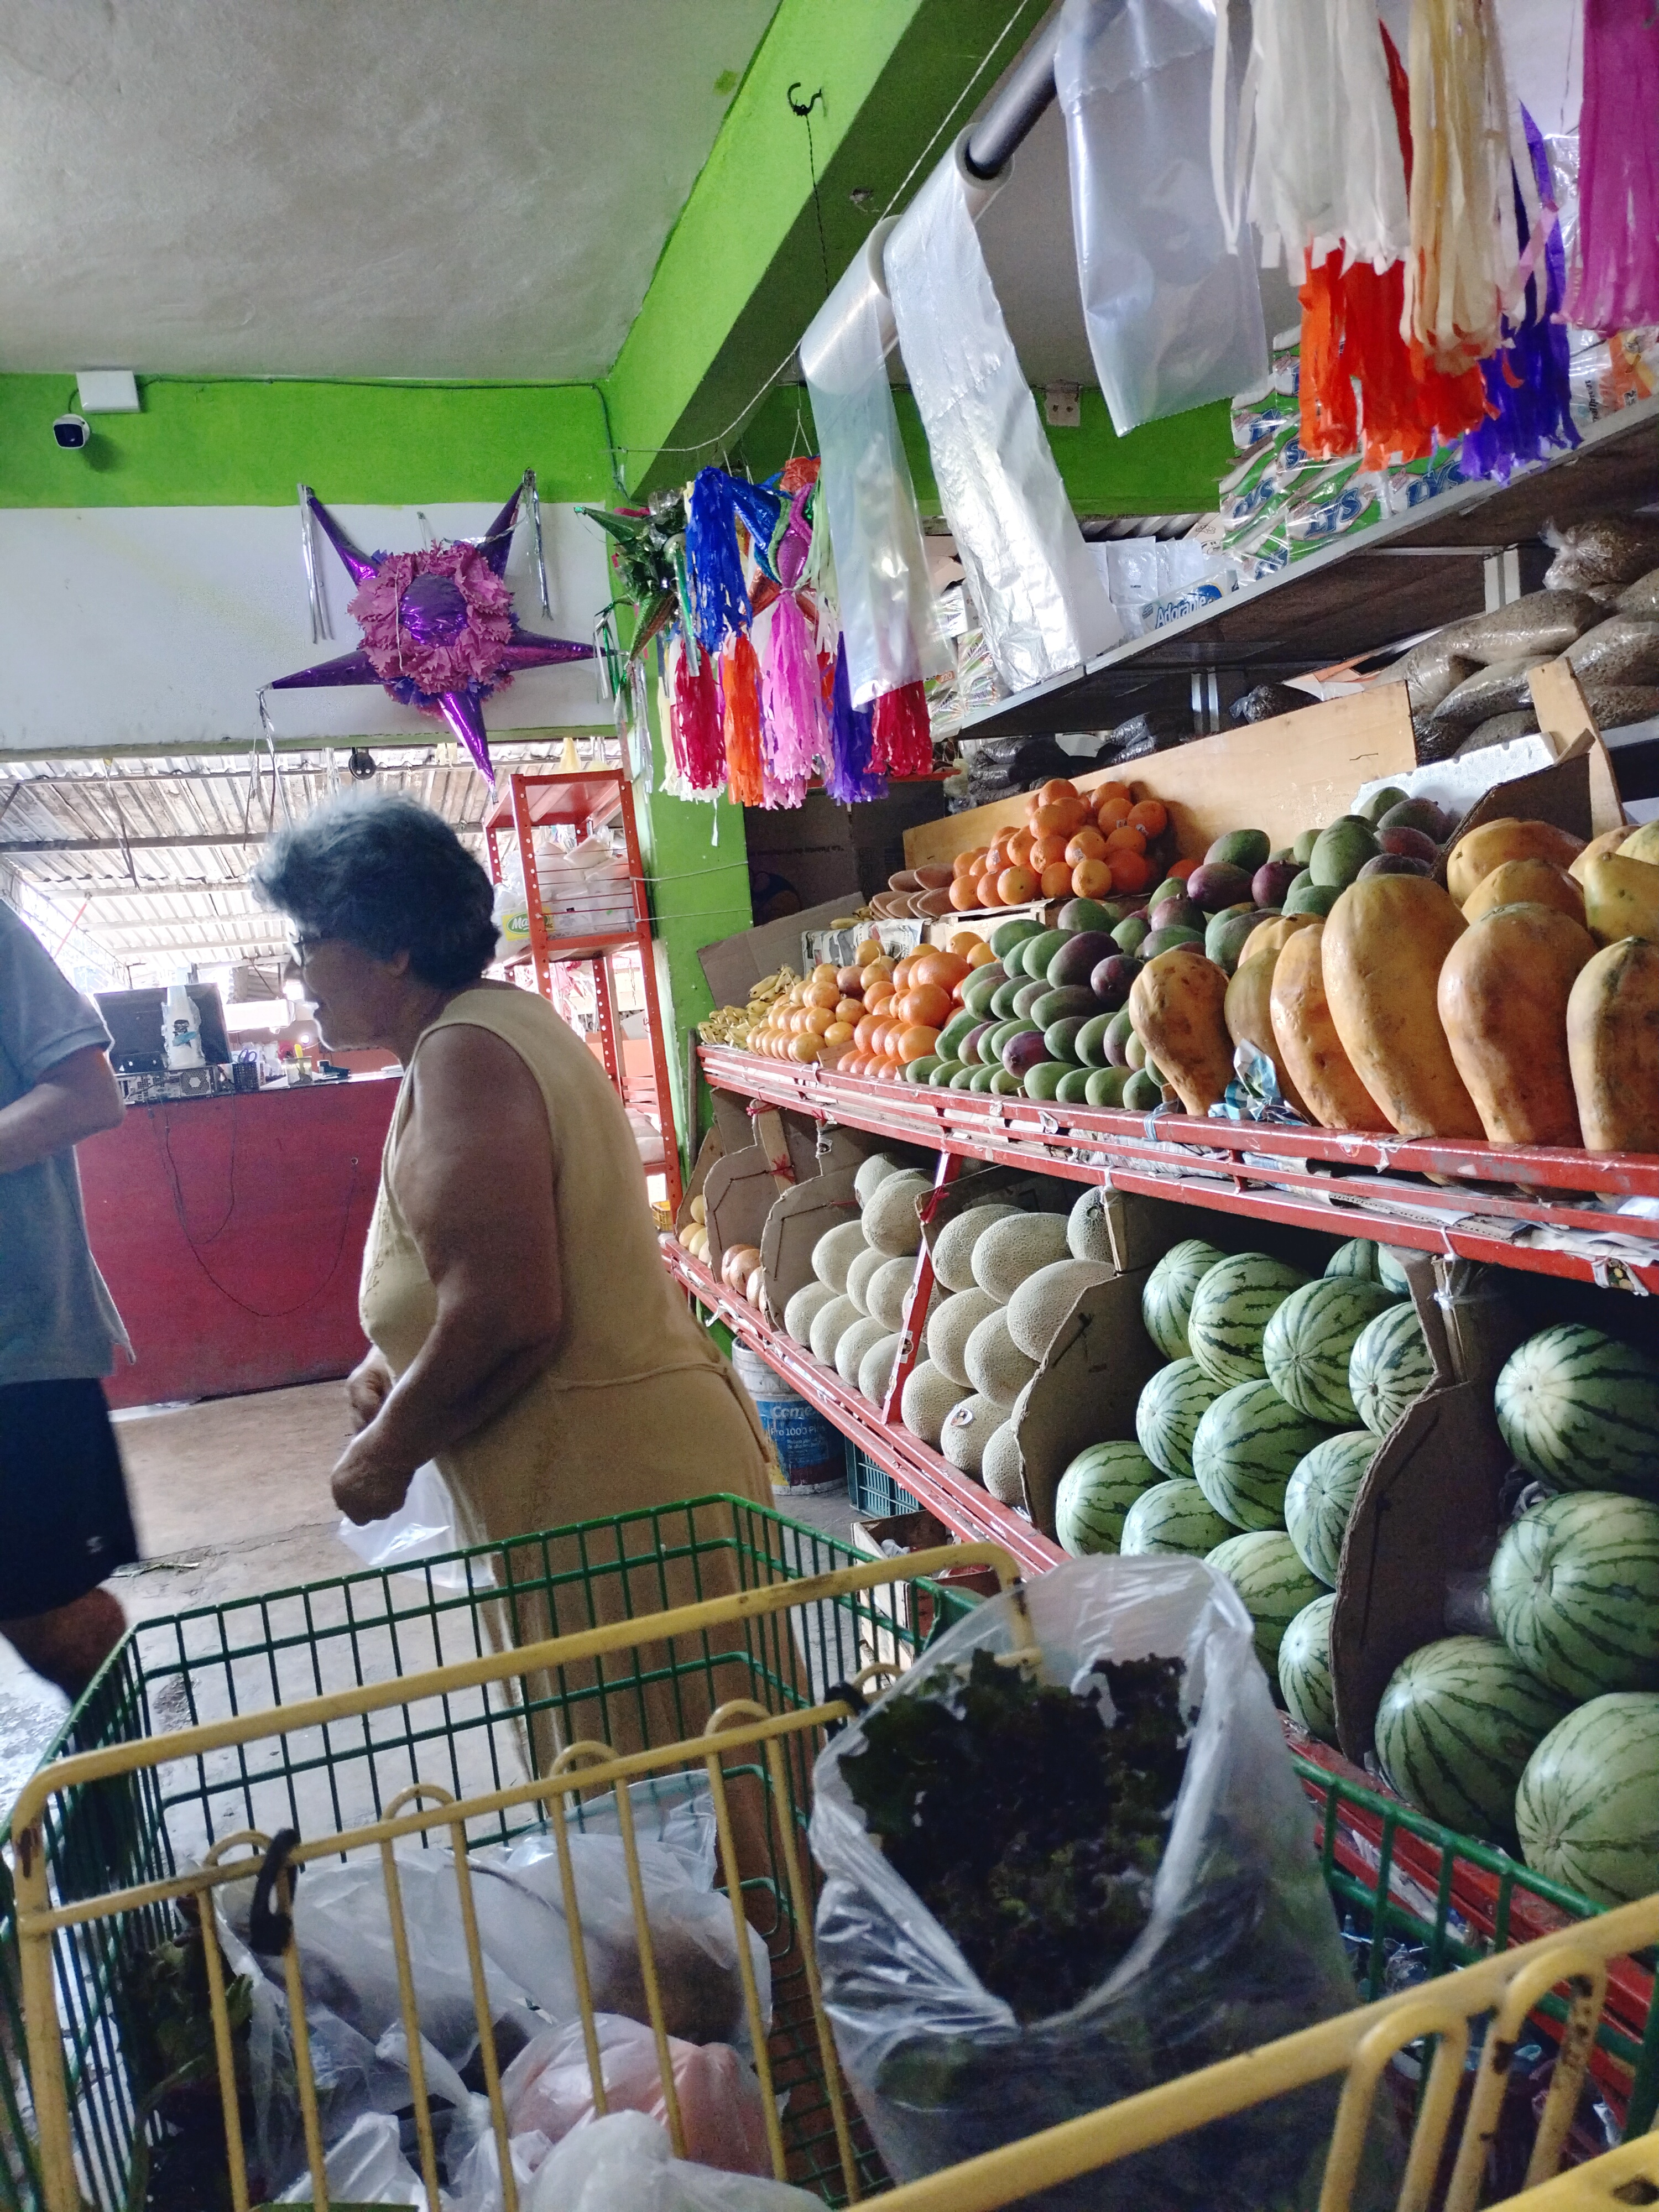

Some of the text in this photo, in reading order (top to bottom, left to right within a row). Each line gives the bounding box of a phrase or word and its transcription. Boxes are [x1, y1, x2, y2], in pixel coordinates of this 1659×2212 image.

[1248, 407, 1281, 445] LY
[1303, 488, 1361, 540] LYS
[941, 671, 953, 683] 220
[512, 917, 529, 930] Ma
[770, 1405, 816, 1420] Come
[785, 1426, 807, 1436] 1000
